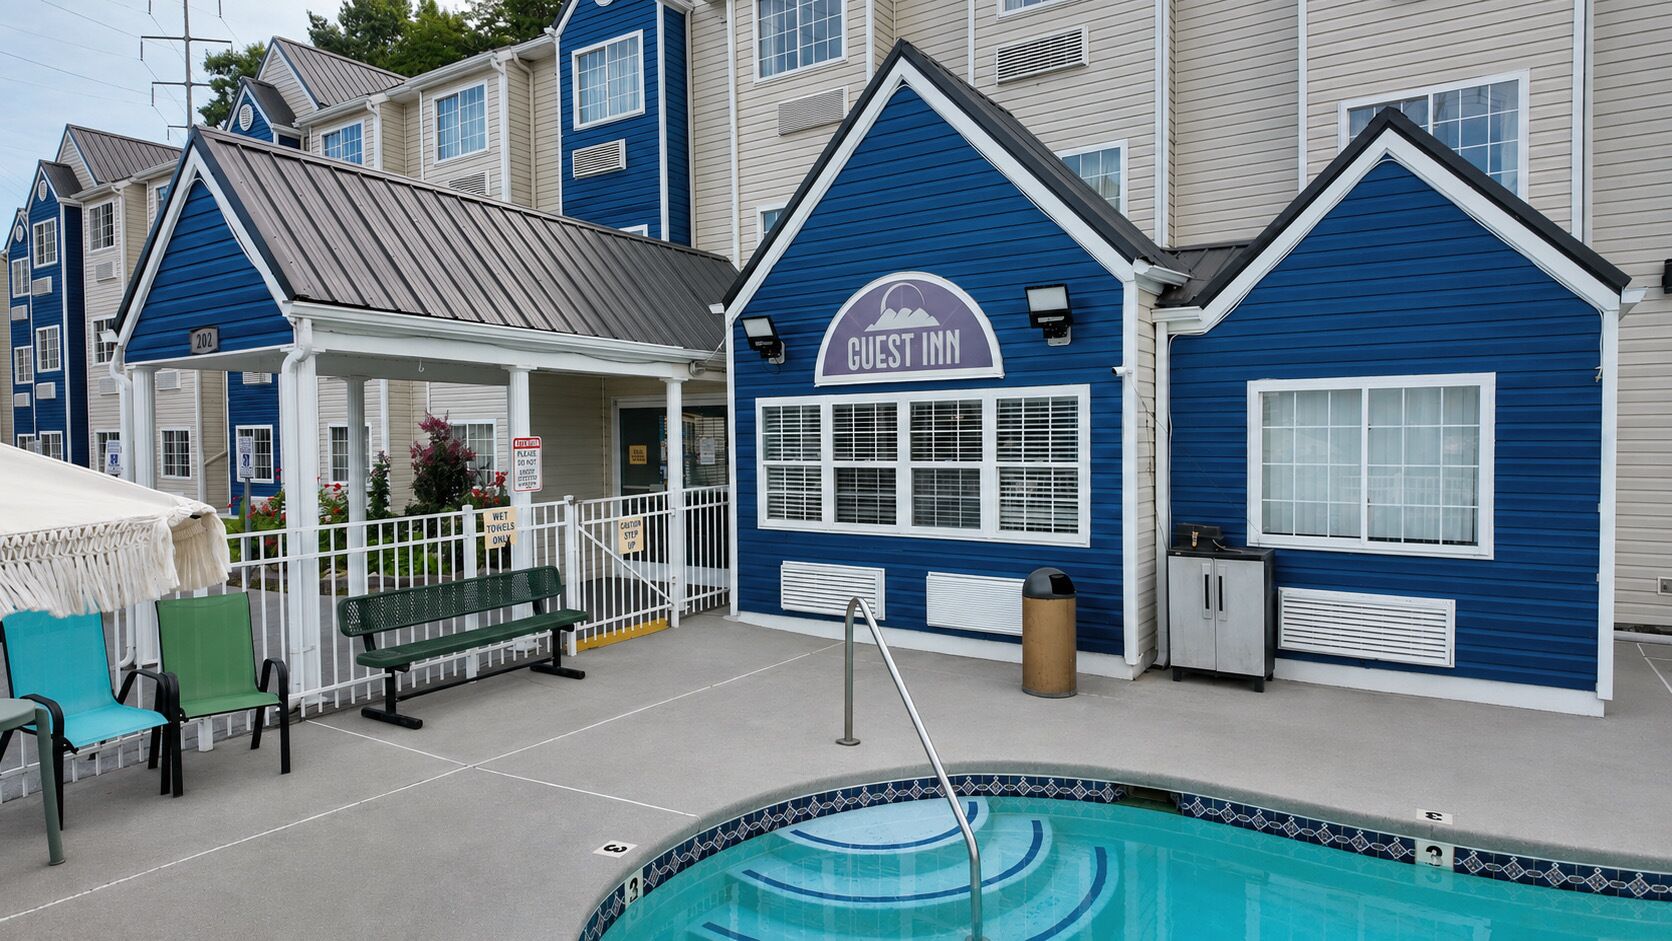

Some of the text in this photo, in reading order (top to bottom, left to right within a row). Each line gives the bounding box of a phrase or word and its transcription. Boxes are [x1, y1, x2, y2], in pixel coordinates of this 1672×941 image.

[197, 332, 212, 349] 202
[848, 329, 960, 371] GUEST INN
[492, 511, 508, 521] WET
[486, 522, 515, 534] TOWELS
[620, 520, 641, 530] CAUTION
[492, 535, 511, 545] ONLY
[624, 530, 639, 540] STEP
[627, 541, 636, 550] UP
[603, 844, 628, 853] 3
[629, 877, 639, 903] 3
